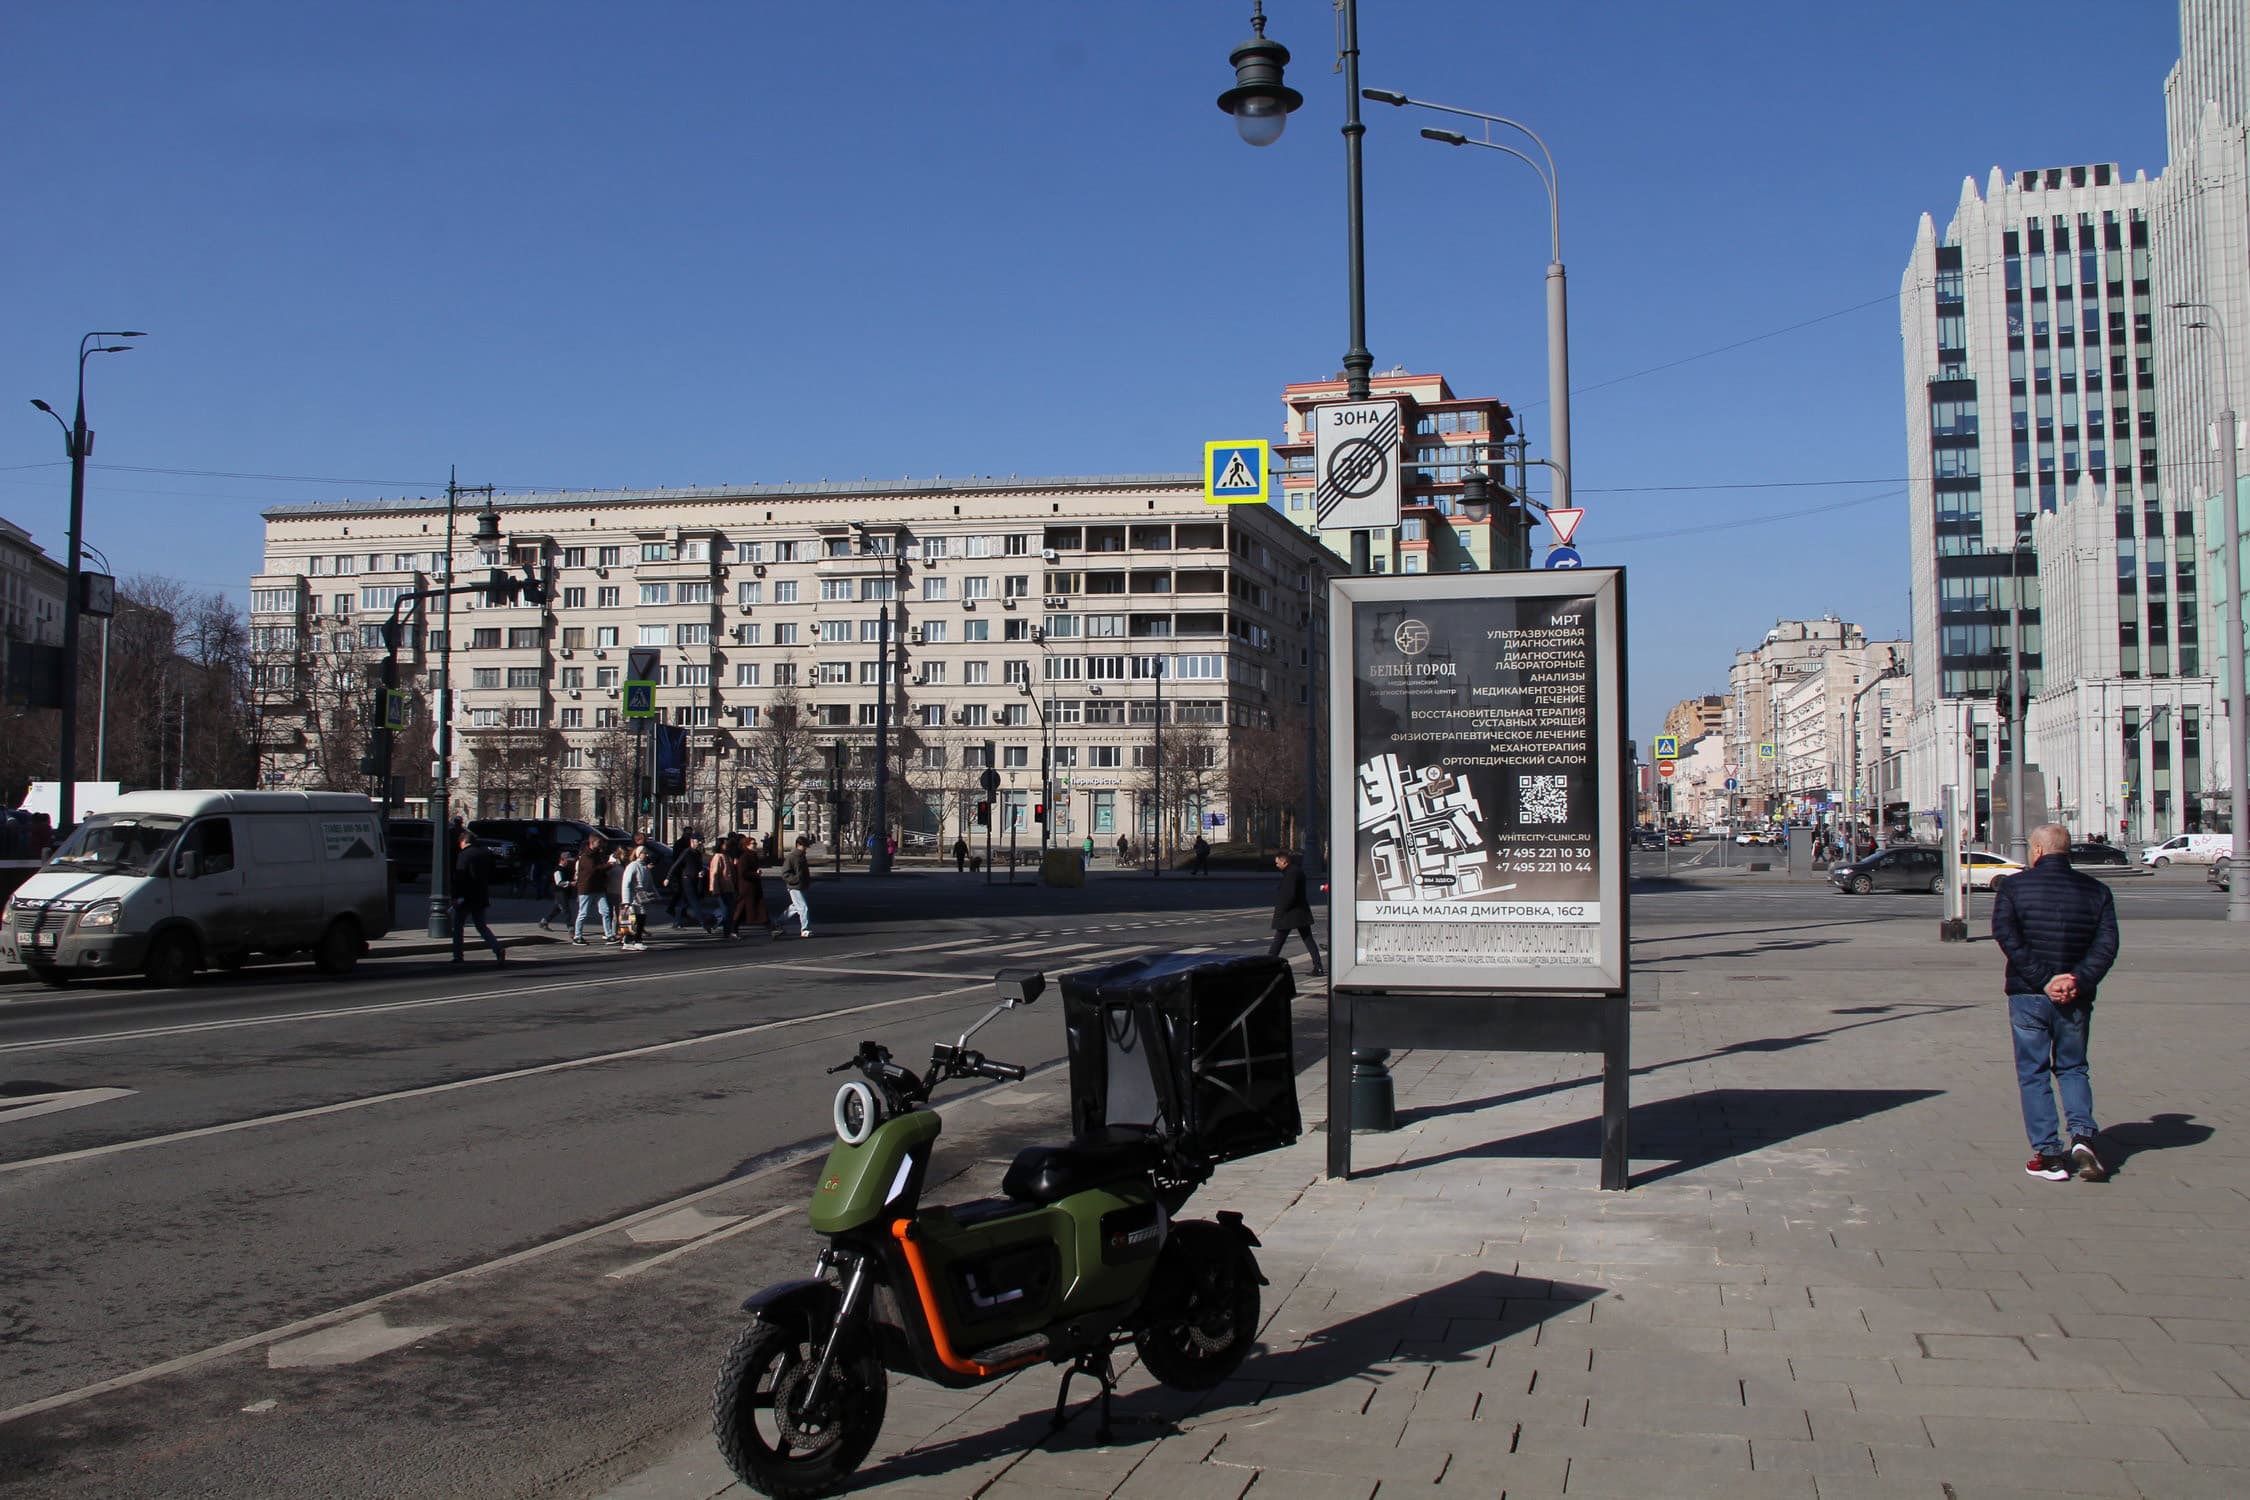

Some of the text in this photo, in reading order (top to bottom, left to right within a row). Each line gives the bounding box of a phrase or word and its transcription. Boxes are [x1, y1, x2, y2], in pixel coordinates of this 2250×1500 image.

[1334, 410, 1379, 426] ЗОНА
[1551, 614, 1582, 626] МРТ
[1487, 628, 1585, 639] УЛЬТРАЗВУКОВАЯ
[1504, 639, 1585, 649] ДИАГНОСТИКА
[1504, 651, 1585, 661] ДИАГНОСТИКА
[1370, 662, 1457, 677] БЕЛЫЙ ГОРОД
[1495, 660, 1585, 670] ЛАБОРАТОРНЫЕ
[1530, 673, 1585, 682] АНАЛИЗЫ
[1434, 688, 1457, 696] центр
[1473, 685, 1586, 696] МЕДИКАМЕНТОЗНОЕ
[1535, 695, 1586, 704] ЛЕЧЕНИЕ
[1411, 708, 1586, 719] ВОССТАНОВИТЕЛЬНАЯ ТЕРАПИЯ
[1472, 717, 1586, 728] СУСТАВНЫХ ХРЯЩЕЙ
[1391, 730, 1586, 742] ФИЗИОТЕРАПЕВТИЧЕСКОЕ ЛЕЧЕНИЕ
[1490, 743, 1586, 753] МЕХАНОТЕРАПИЯ
[1442, 754, 1586, 766] ОРТОПЕДИЧЕСКИЙ САЛОН
[1498, 833, 1591, 842] WHITECITY-CLINIC.RU
[1496, 848, 1591, 858] +7 495 221 10 30
[1496, 862, 1592, 872] +7 495 221 10 44
[1375, 905, 1585, 917] УЛИЦА МАЛАЯ ДМИТРОВКА, 16С2
